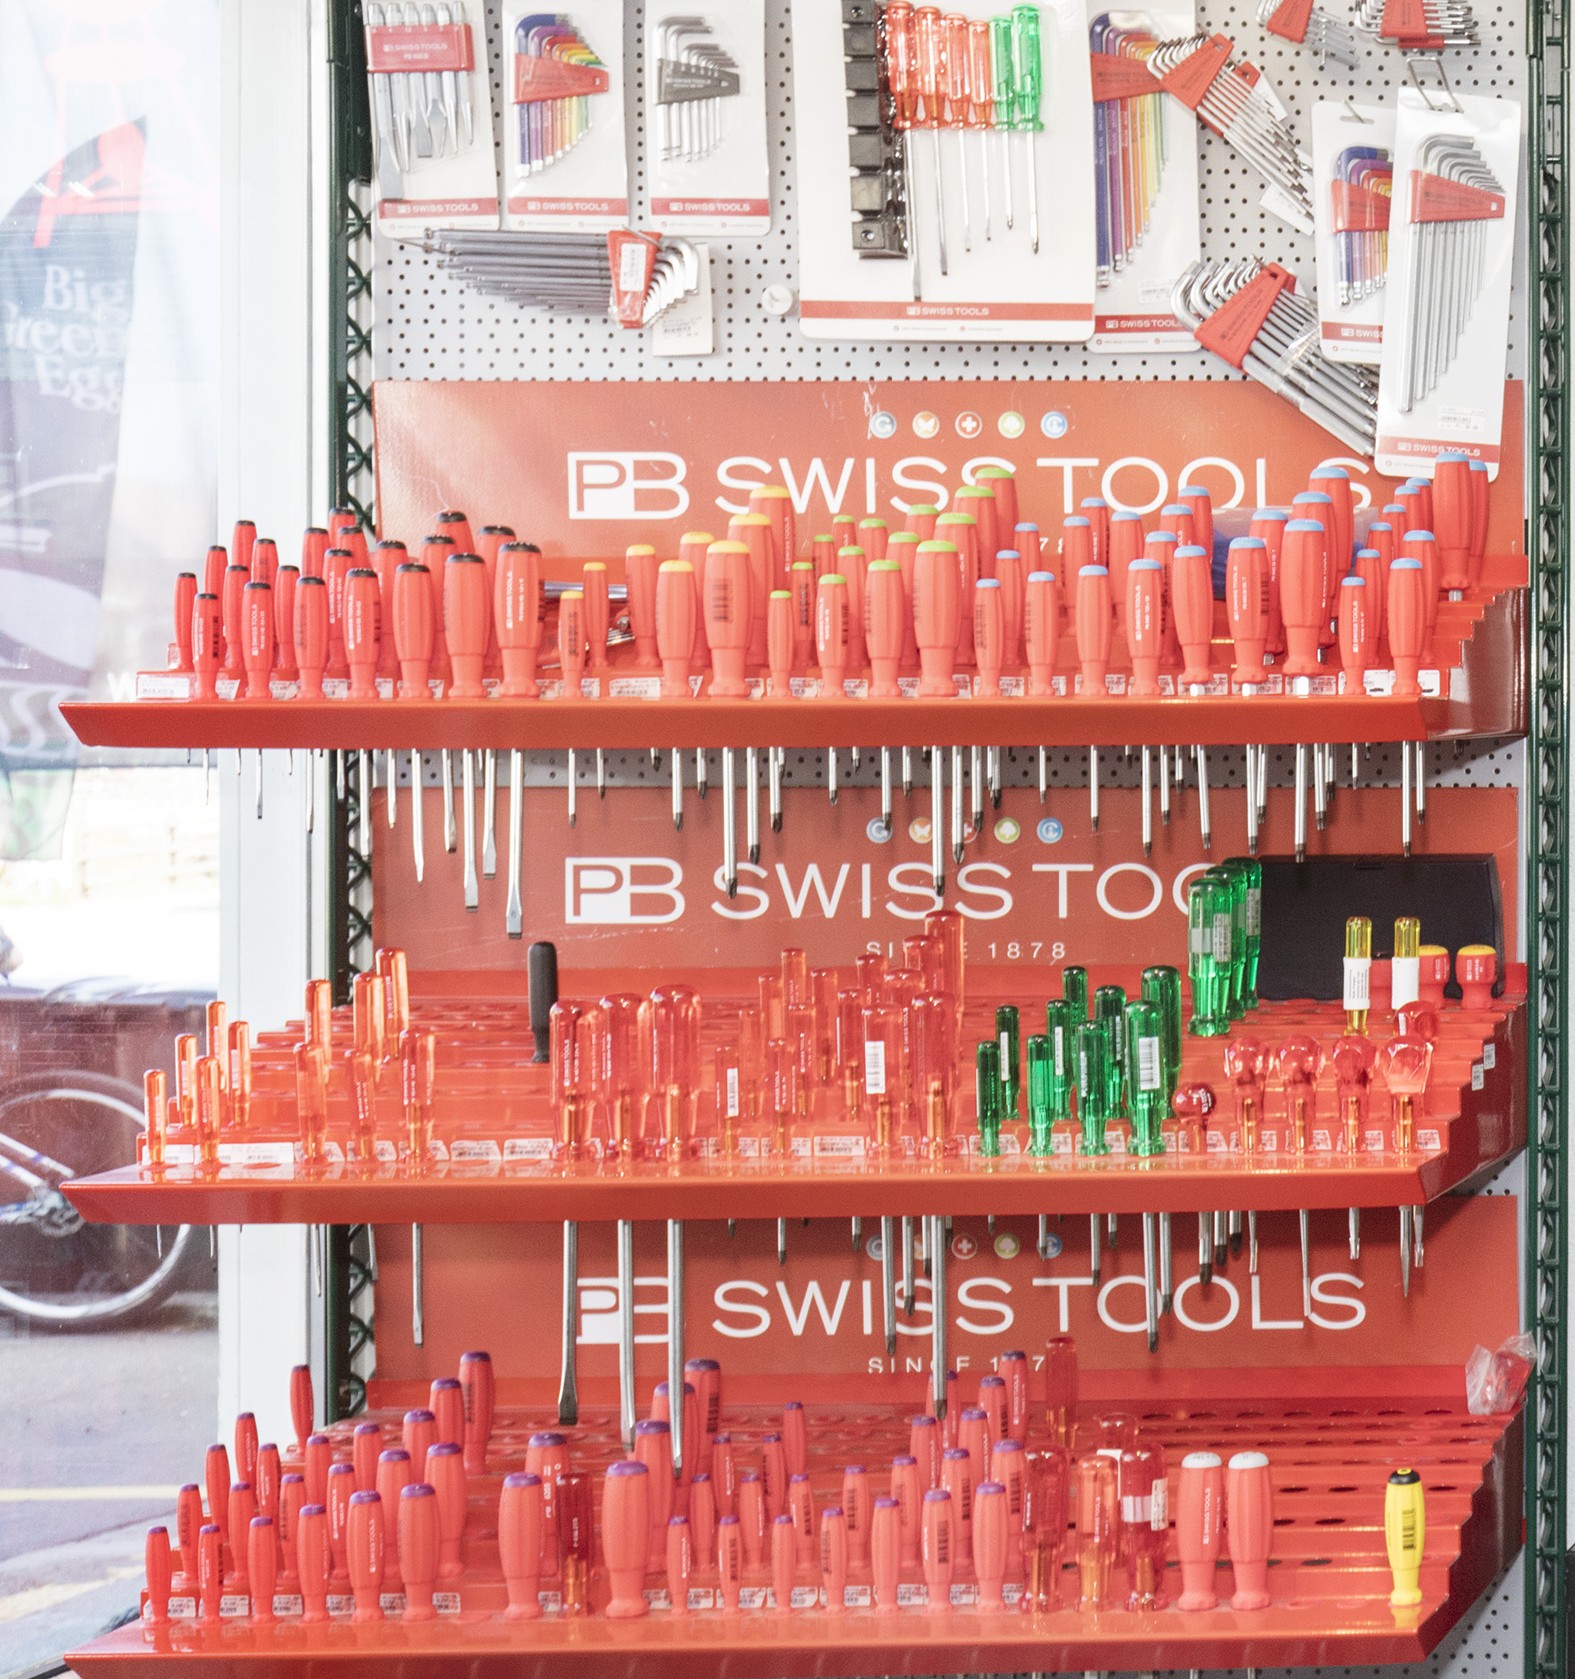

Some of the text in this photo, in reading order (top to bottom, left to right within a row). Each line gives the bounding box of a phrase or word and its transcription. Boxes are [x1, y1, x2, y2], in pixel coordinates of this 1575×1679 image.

[412, 203, 443, 213] SWISS
[446, 202, 478, 212] TOOLS
[542, 201, 573, 211] SWISS
[575, 201, 608, 211] TOOLS
[685, 201, 715, 211] SWISS
[718, 201, 751, 211] TOOLS
[42, 264, 127, 322] Big
[922, 306, 952, 316] SWISS
[954, 306, 989, 316] TOOLS
[1120, 319, 1148, 328] SWISS
[1151, 319, 1180, 328] TOOL
[1413, 442, 1445, 454] SWISS
[1446, 445, 1480, 456] TOOLS
[567, 451, 690, 520] PB
[251, 604, 259, 647] SWISS TOOLS
[565, 856, 687, 925] PB
[711, 861, 1013, 920] SWISS
[987, 941, 1066, 960] 1878
[712, 1277, 1015, 1338] SWISS
[1032, 1273, 1367, 1333] TOOLS
[1203, 1513, 1211, 1535] SWISS
